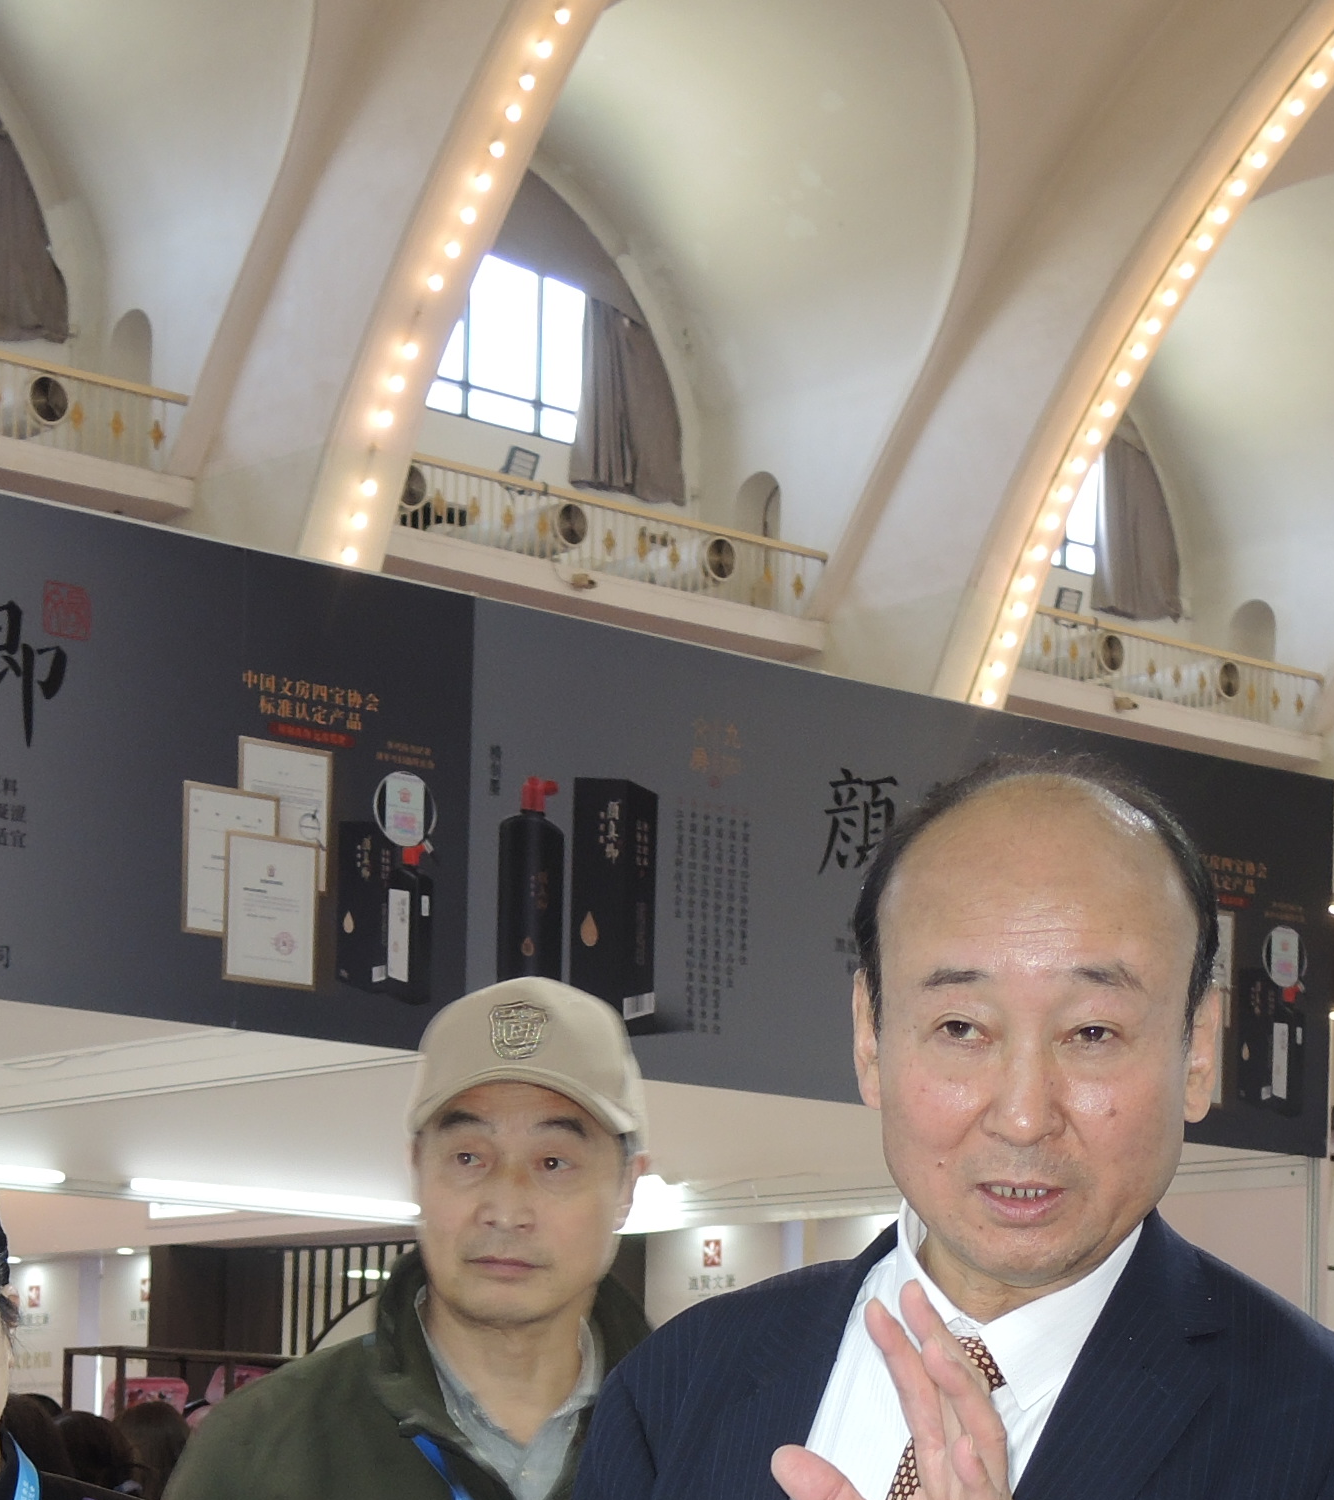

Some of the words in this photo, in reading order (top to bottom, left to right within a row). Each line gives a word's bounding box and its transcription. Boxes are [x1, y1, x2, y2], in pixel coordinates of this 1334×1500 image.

[242, 669, 380, 713] 中国文房四宝协会
[269, 695, 362, 731] 标准认定产品
